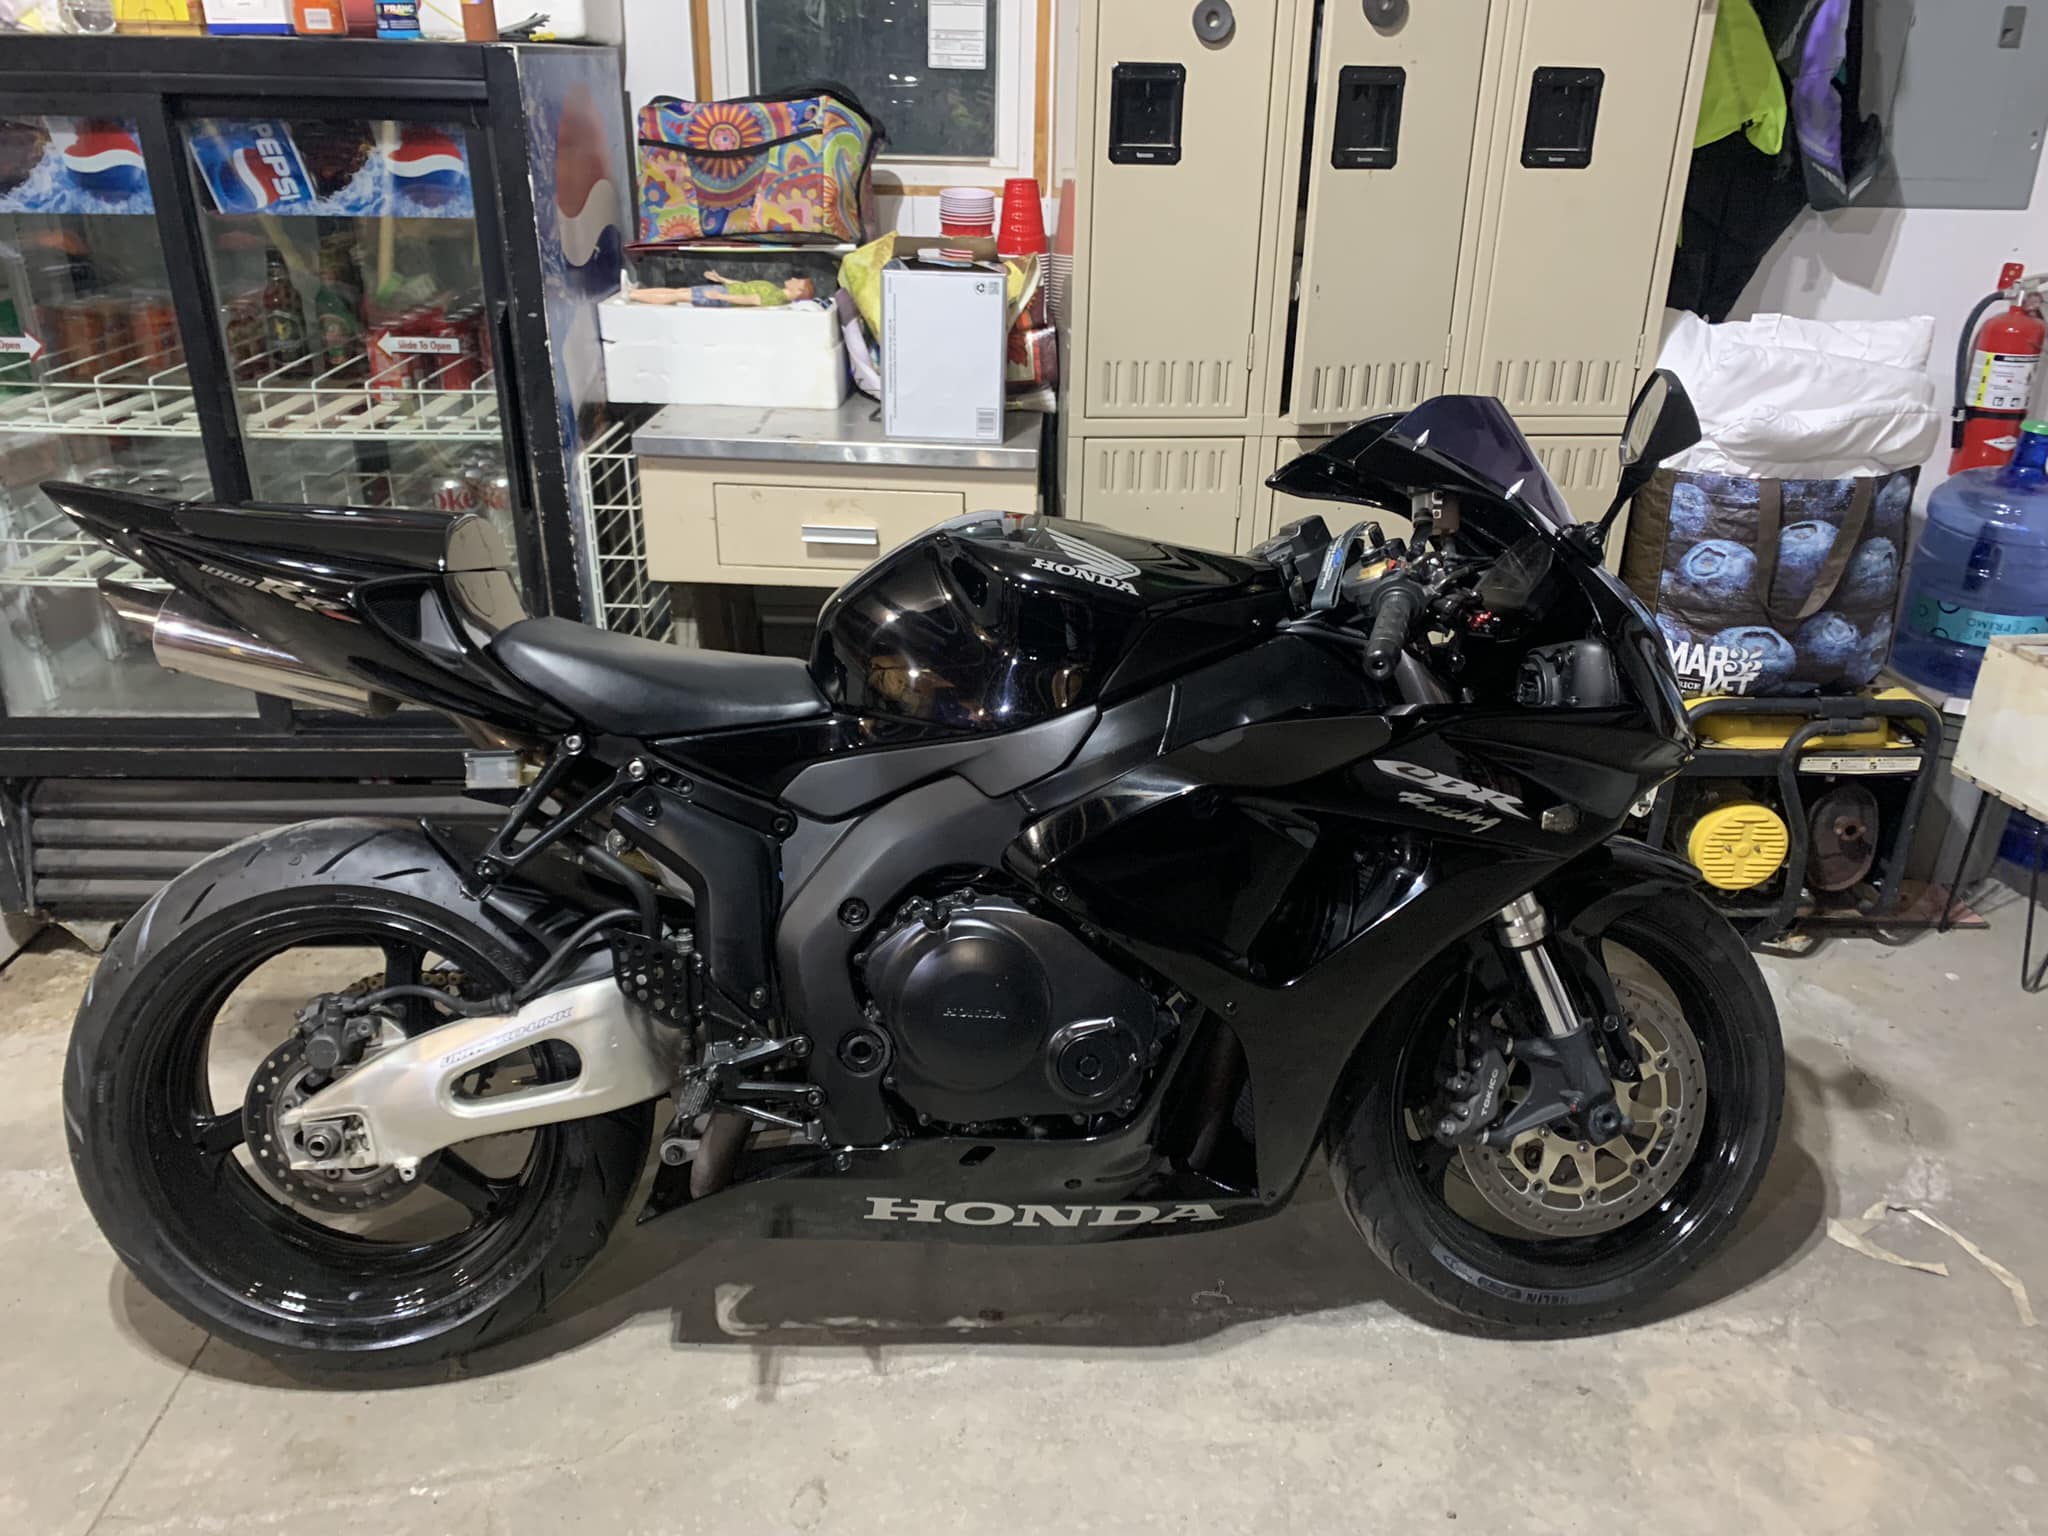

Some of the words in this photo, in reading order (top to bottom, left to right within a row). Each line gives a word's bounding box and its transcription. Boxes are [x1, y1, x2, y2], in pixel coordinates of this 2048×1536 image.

[249, 122, 302, 201] PEPSI
[419, 340, 429, 350] To
[430, 340, 453, 351] Open
[1031, 557, 1140, 596] HONDA
[1679, 680, 1702, 691] RICE
[1480, 1067, 1499, 1118] TOKICO
[863, 1196, 1225, 1227] HONDA
